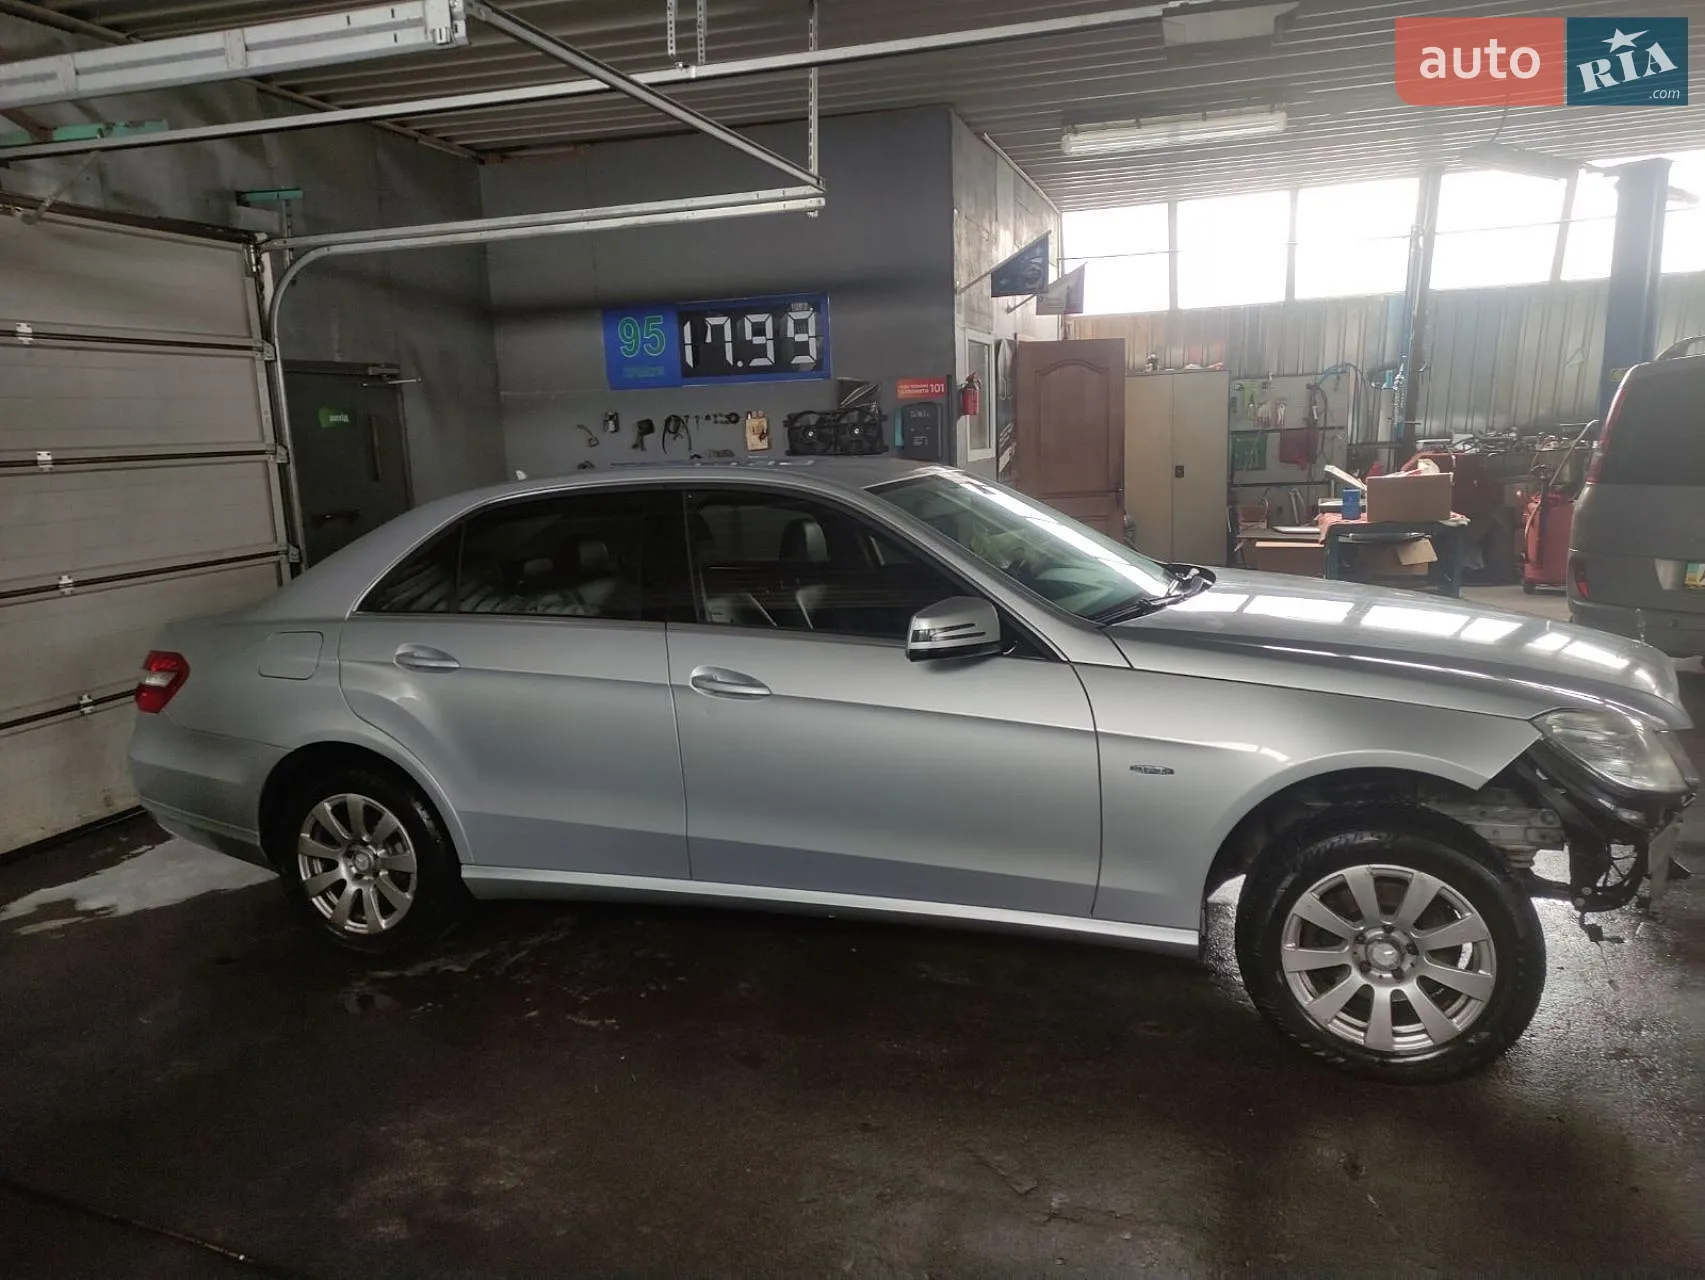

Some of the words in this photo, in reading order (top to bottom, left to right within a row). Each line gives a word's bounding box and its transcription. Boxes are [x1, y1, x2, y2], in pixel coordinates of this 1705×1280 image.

[617, 315, 666, 358] 95
[683, 310, 817, 368] 17.99
[930, 383, 945, 393] 101
